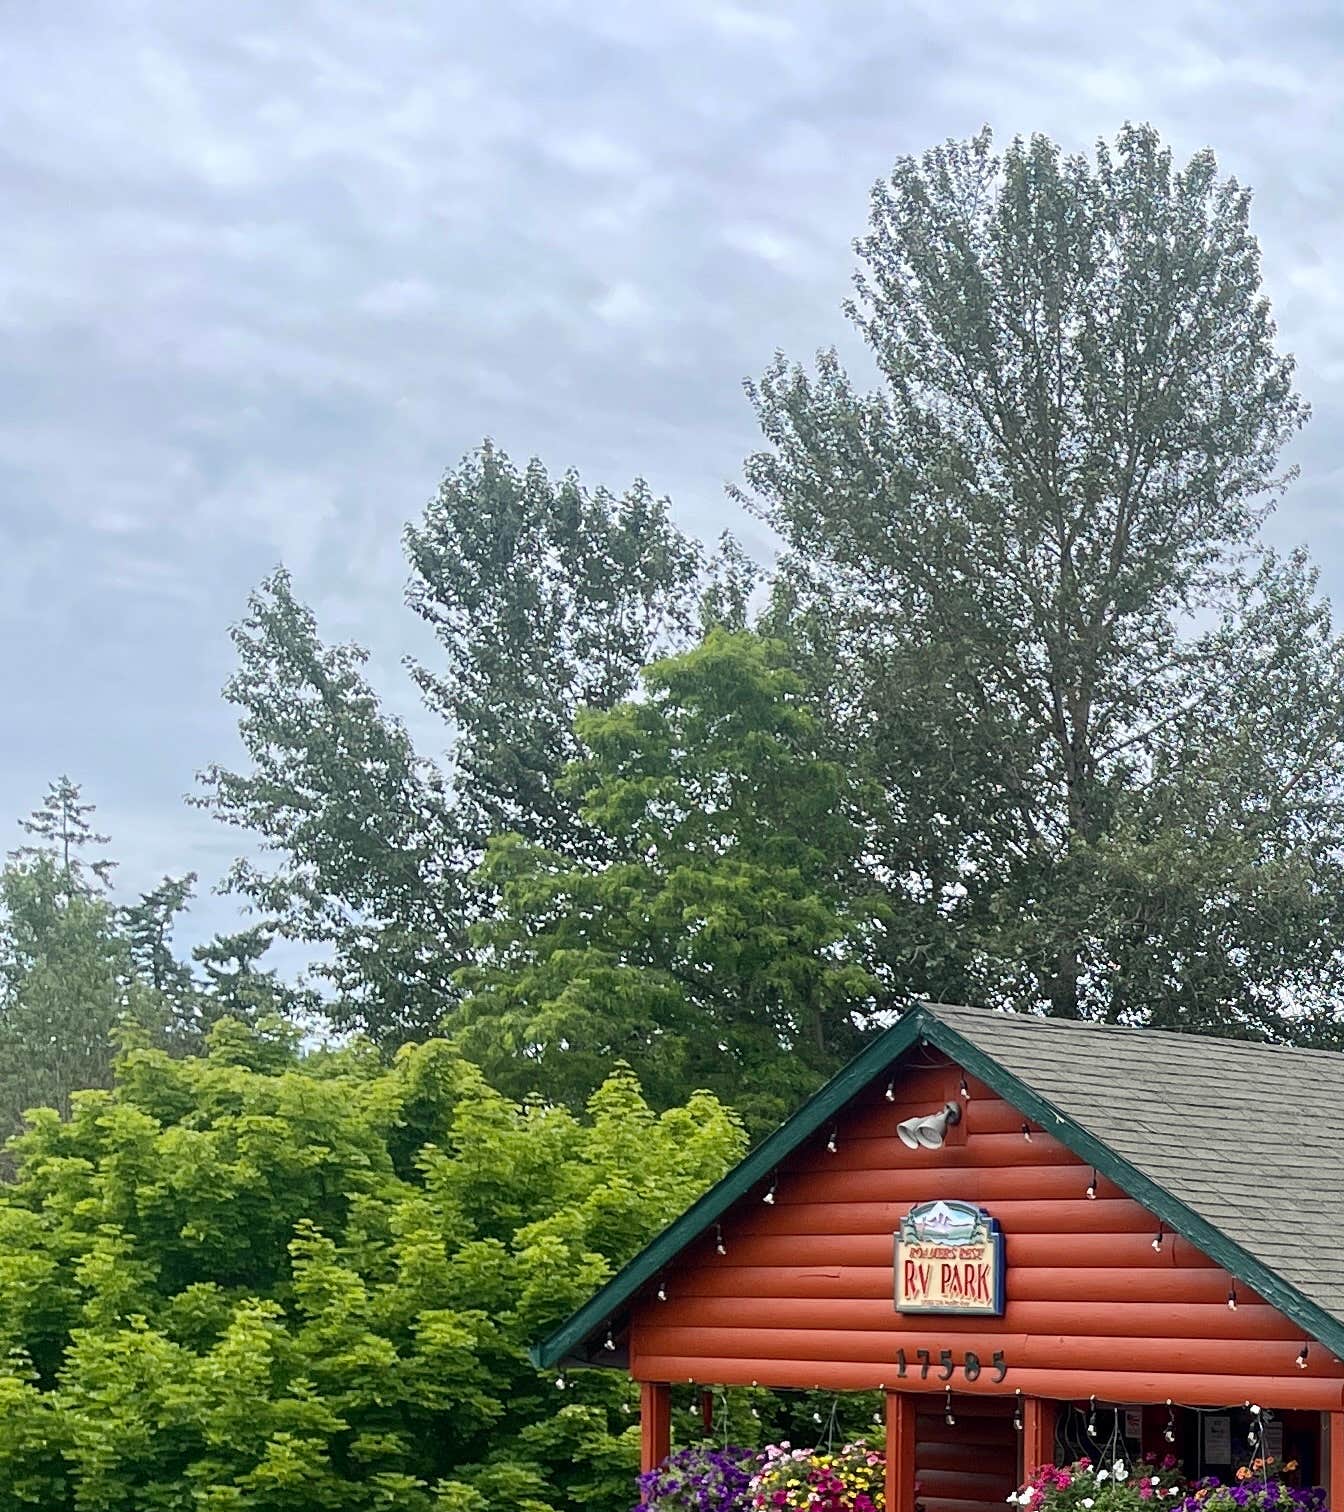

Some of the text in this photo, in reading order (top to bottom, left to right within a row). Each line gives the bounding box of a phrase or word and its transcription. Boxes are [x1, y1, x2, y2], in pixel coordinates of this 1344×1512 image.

[904, 1259, 991, 1303] RV PARK
[896, 1347, 1008, 1384] 17585
